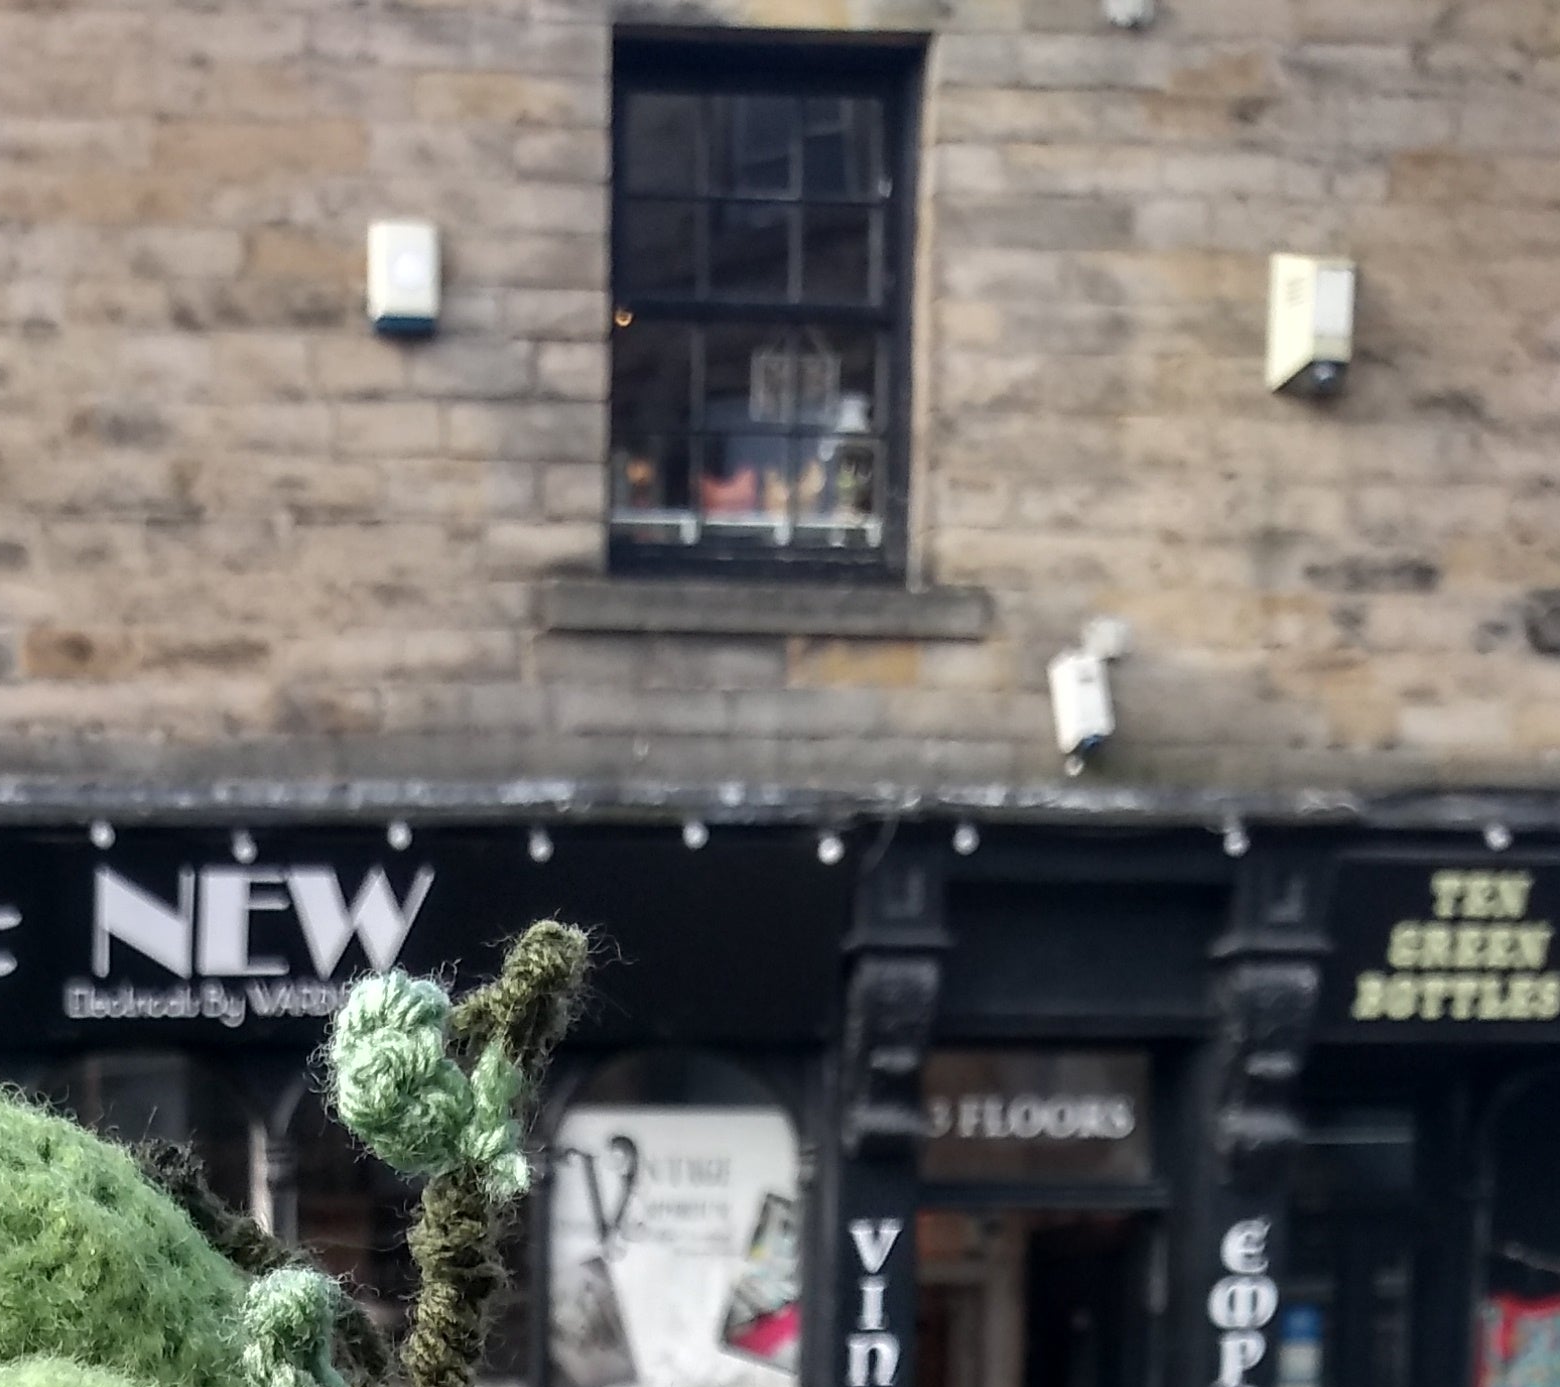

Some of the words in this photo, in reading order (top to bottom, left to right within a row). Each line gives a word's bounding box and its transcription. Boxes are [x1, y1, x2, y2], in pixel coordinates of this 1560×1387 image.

[1430, 868, 1533, 919] TEN
[91, 864, 435, 979] NEW
[1387, 919, 1555, 970] GREEN
[958, 1095, 1136, 1139] FLOORS
